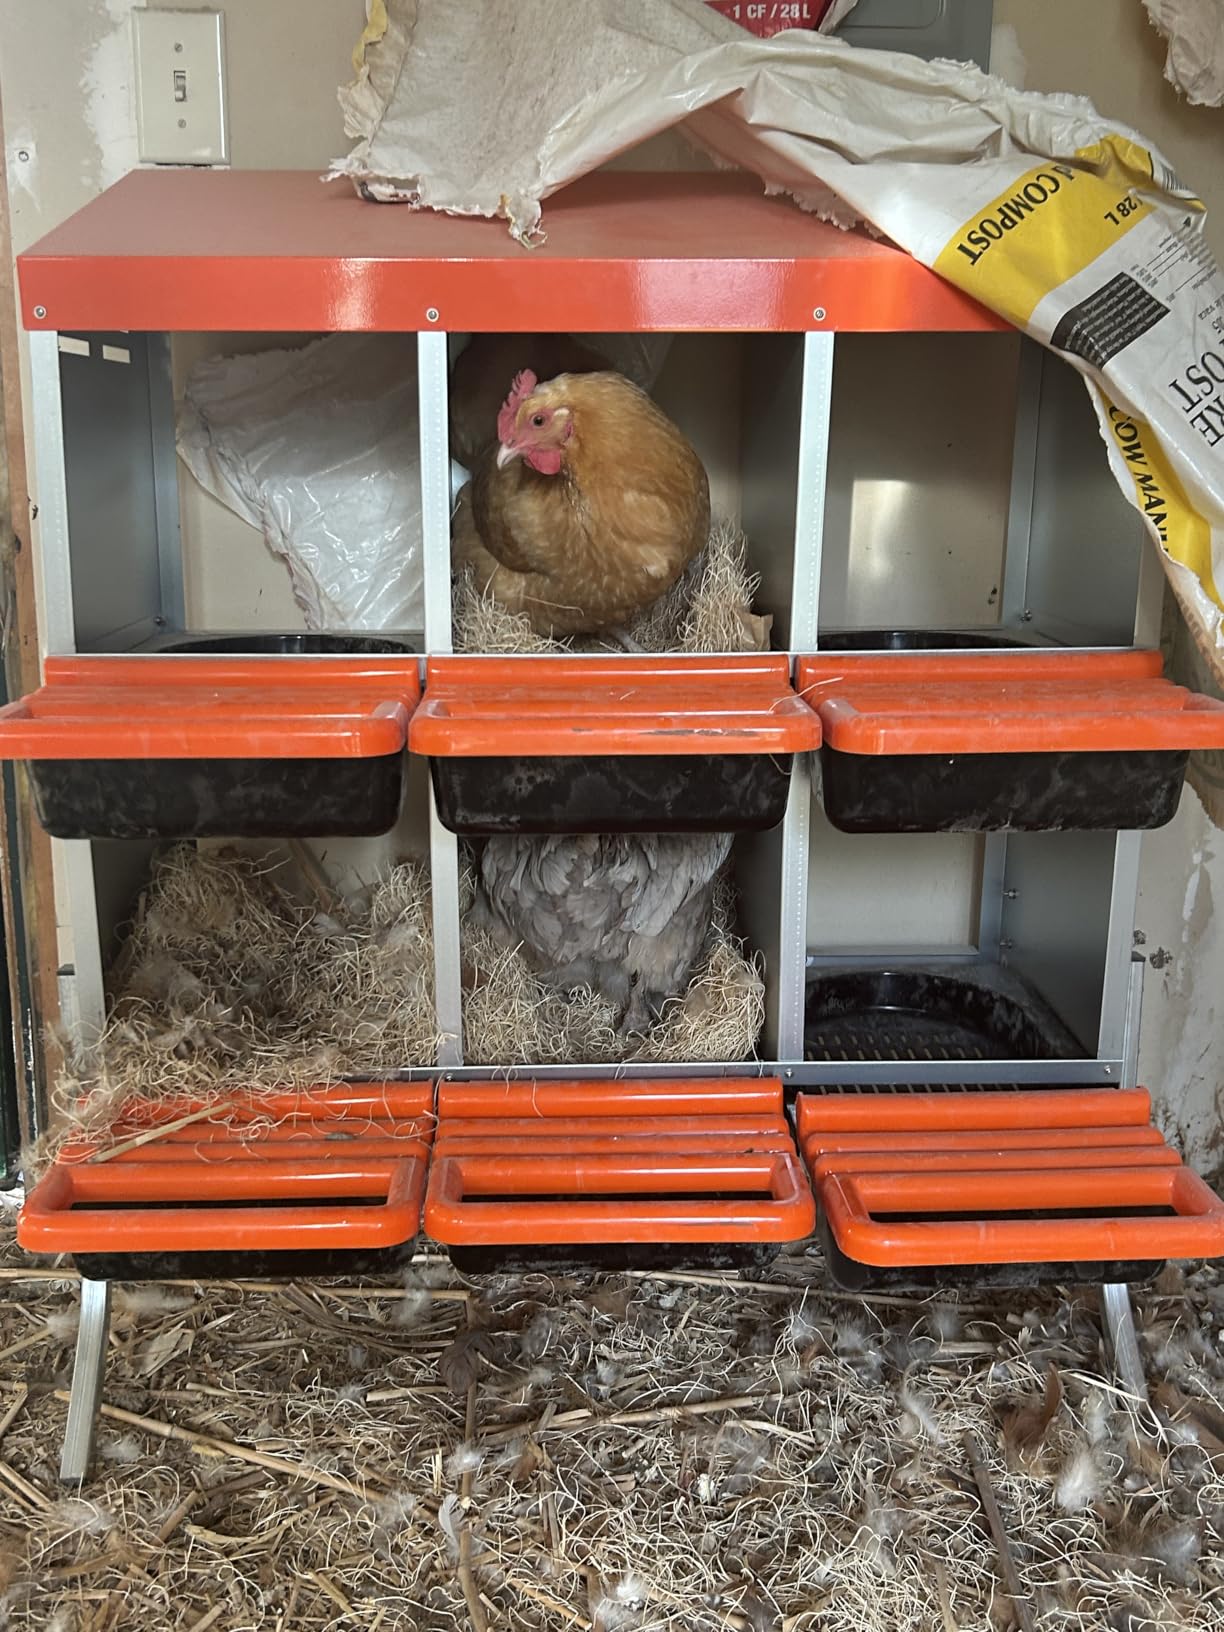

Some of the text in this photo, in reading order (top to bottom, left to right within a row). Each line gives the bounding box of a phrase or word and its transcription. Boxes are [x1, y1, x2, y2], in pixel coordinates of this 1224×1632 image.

[733, 4, 740, 19] 1
[747, 3, 766, 19] CF
[780, 4, 800, 19] 28
[956, 173, 1061, 266] COMPOST
[1104, 212, 1119, 226] L
[1168, 337, 1224, 413] OST
[1108, 405, 1147, 466] COW
